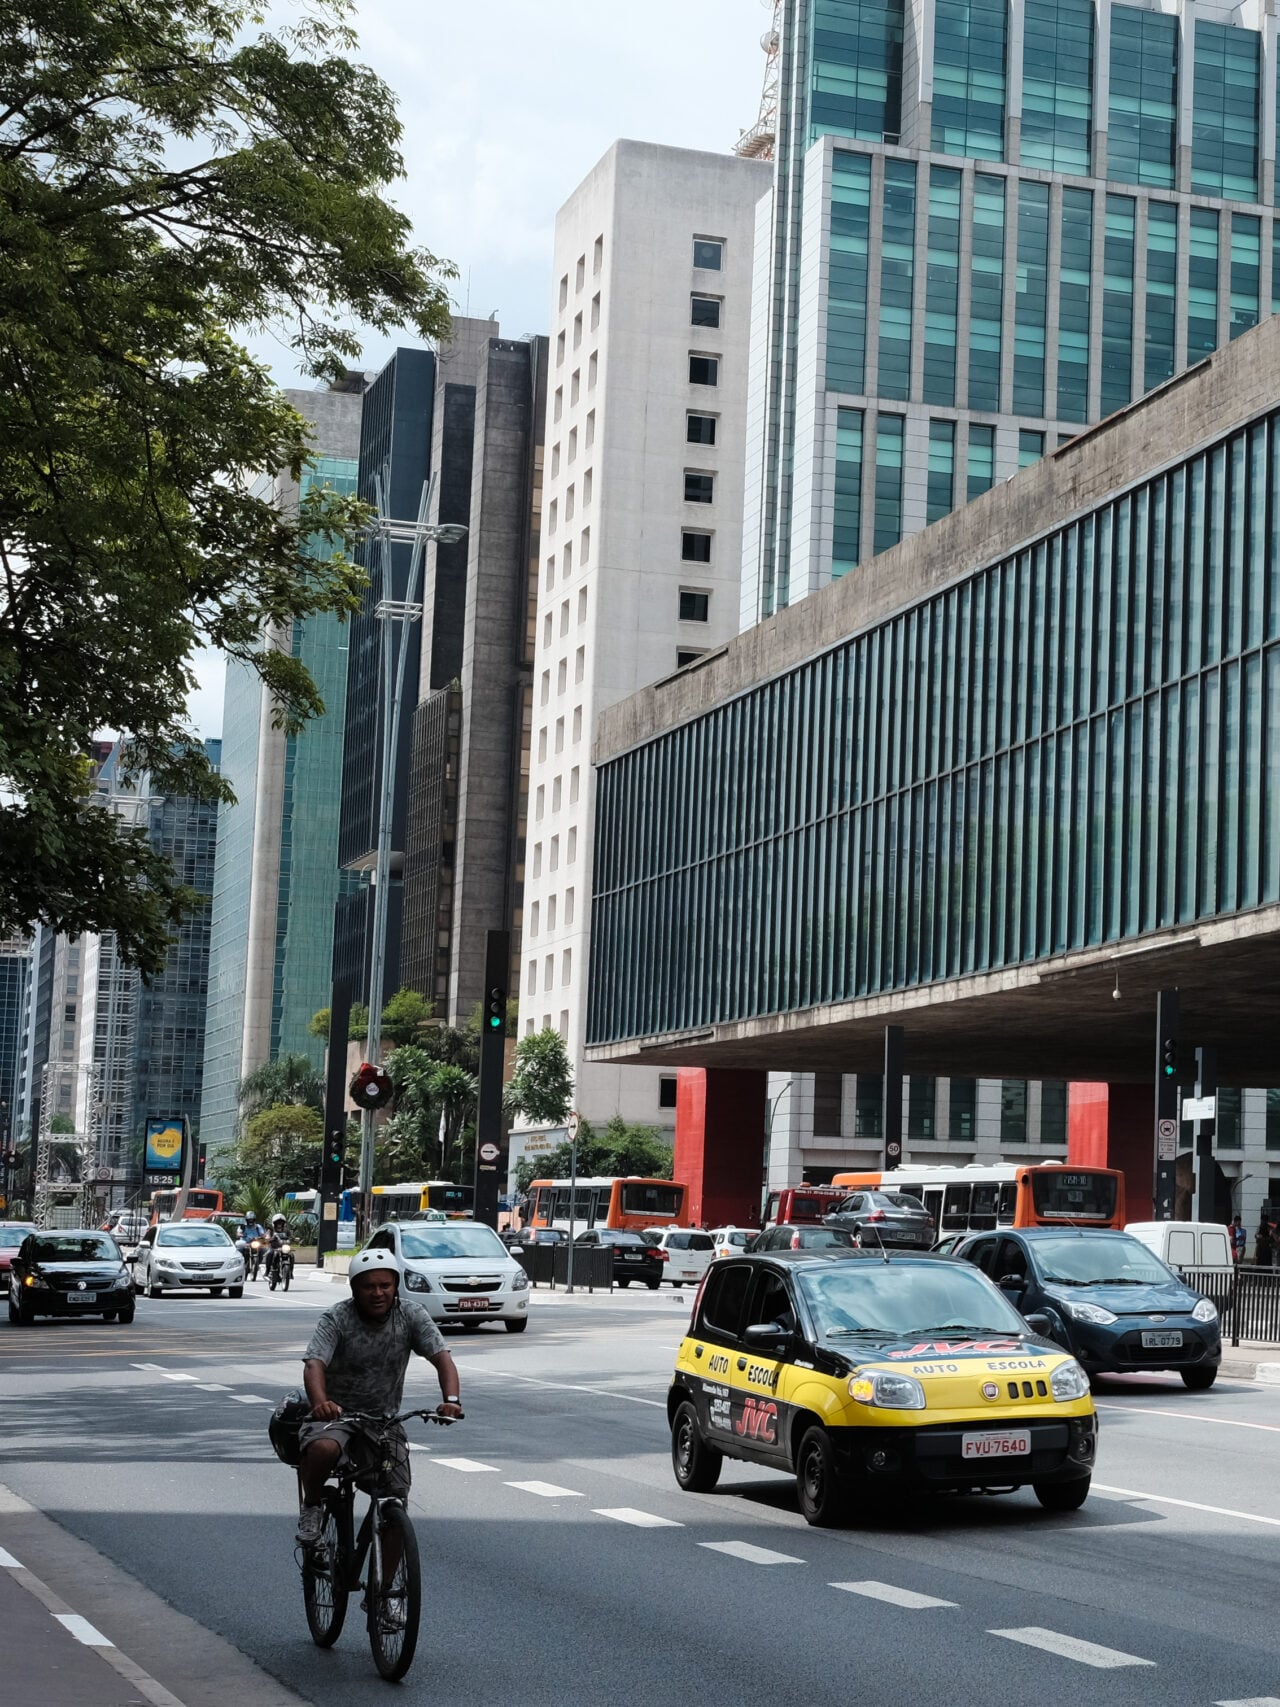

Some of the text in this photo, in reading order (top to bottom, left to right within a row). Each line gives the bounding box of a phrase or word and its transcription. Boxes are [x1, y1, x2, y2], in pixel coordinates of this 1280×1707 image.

[148, 1175, 173, 1184] 15:25
[888, 1340, 1020, 1358] JVC
[709, 1354, 780, 1388] AUTO ESCOLA
[913, 1360, 1047, 1374] AUTO ESCOLA
[735, 1397, 778, 1443] JVC
